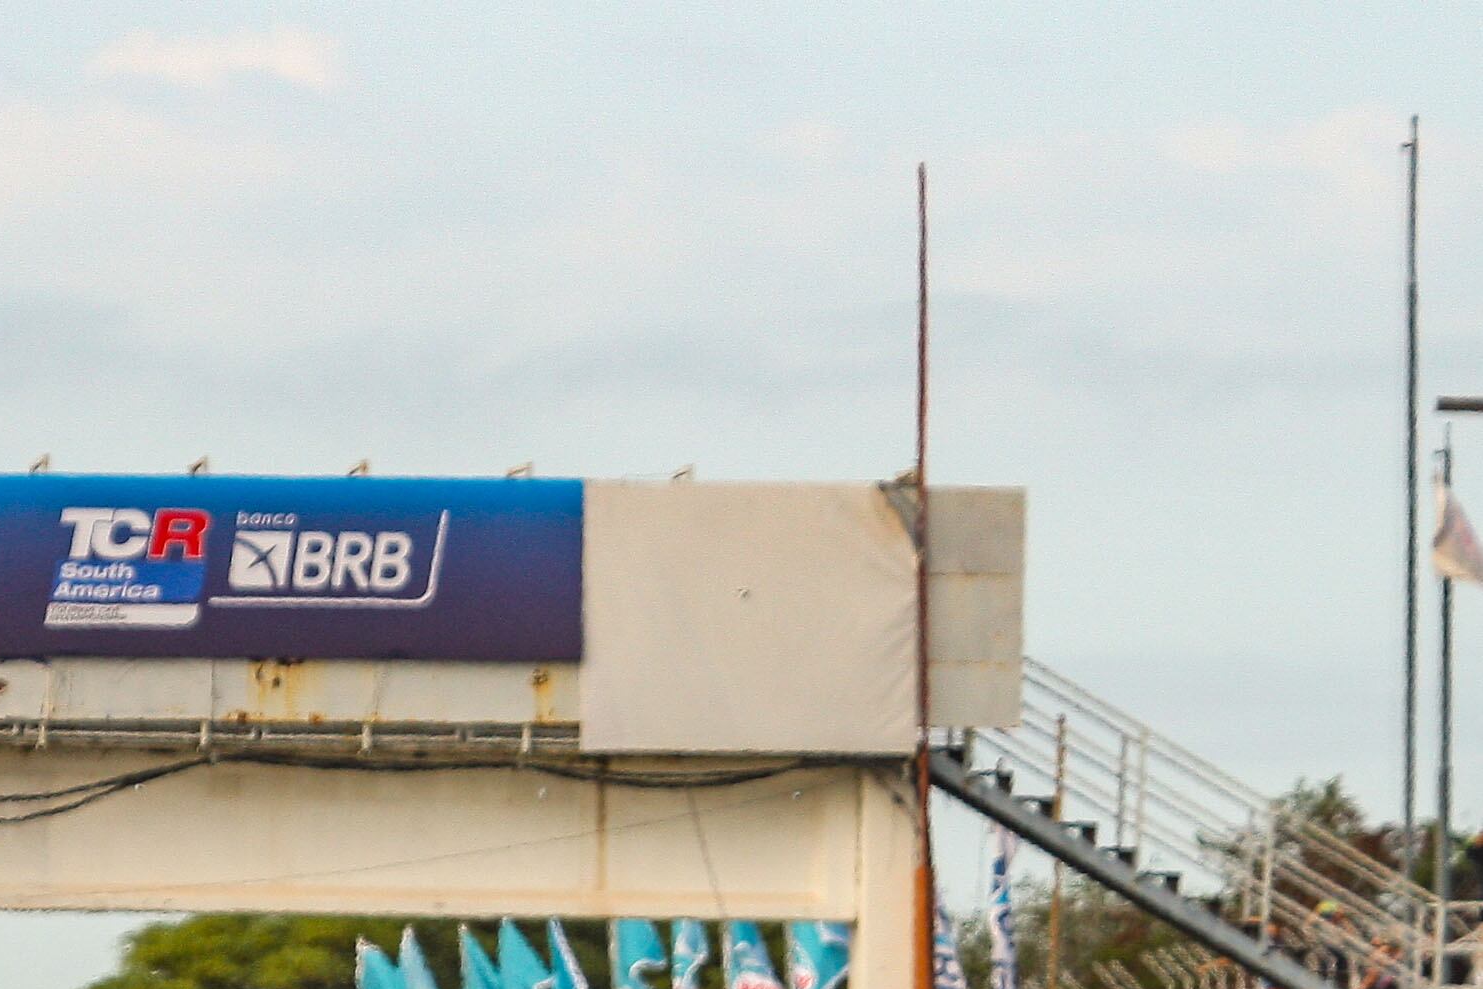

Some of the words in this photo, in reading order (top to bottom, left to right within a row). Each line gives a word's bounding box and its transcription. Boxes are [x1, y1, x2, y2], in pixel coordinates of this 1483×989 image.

[236, 511, 297, 525] banco
[61, 507, 210, 560] TCR
[292, 531, 412, 592] BRB
[61, 563, 133, 579] South
[55, 583, 160, 599] America
